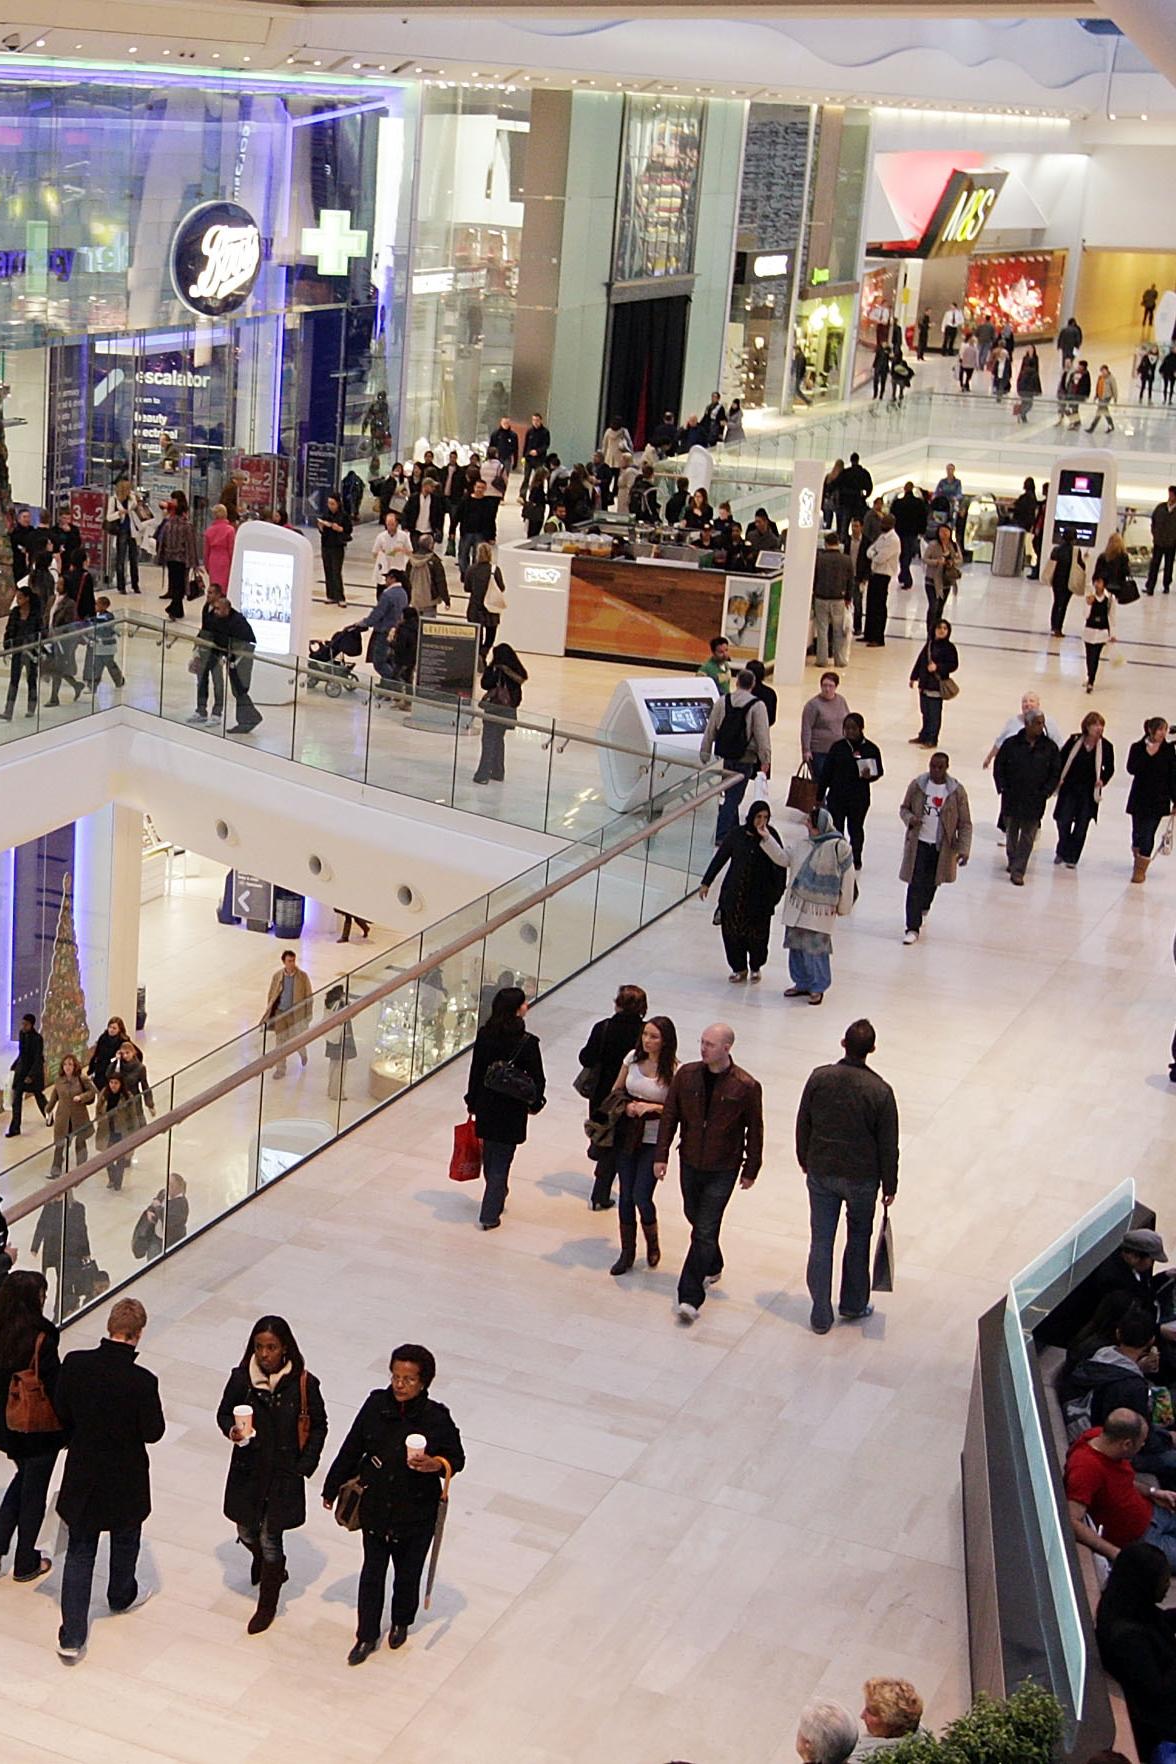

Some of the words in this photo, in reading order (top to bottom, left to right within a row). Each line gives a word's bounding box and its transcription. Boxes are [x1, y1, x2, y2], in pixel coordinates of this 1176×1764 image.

[942, 187, 996, 242] M&S
[188, 224, 260, 299] Boots
[135, 369, 211, 388] escalator
[263, 472, 272, 486] 2
[72, 504, 82, 520] 3
[95, 506, 104, 522] 2
